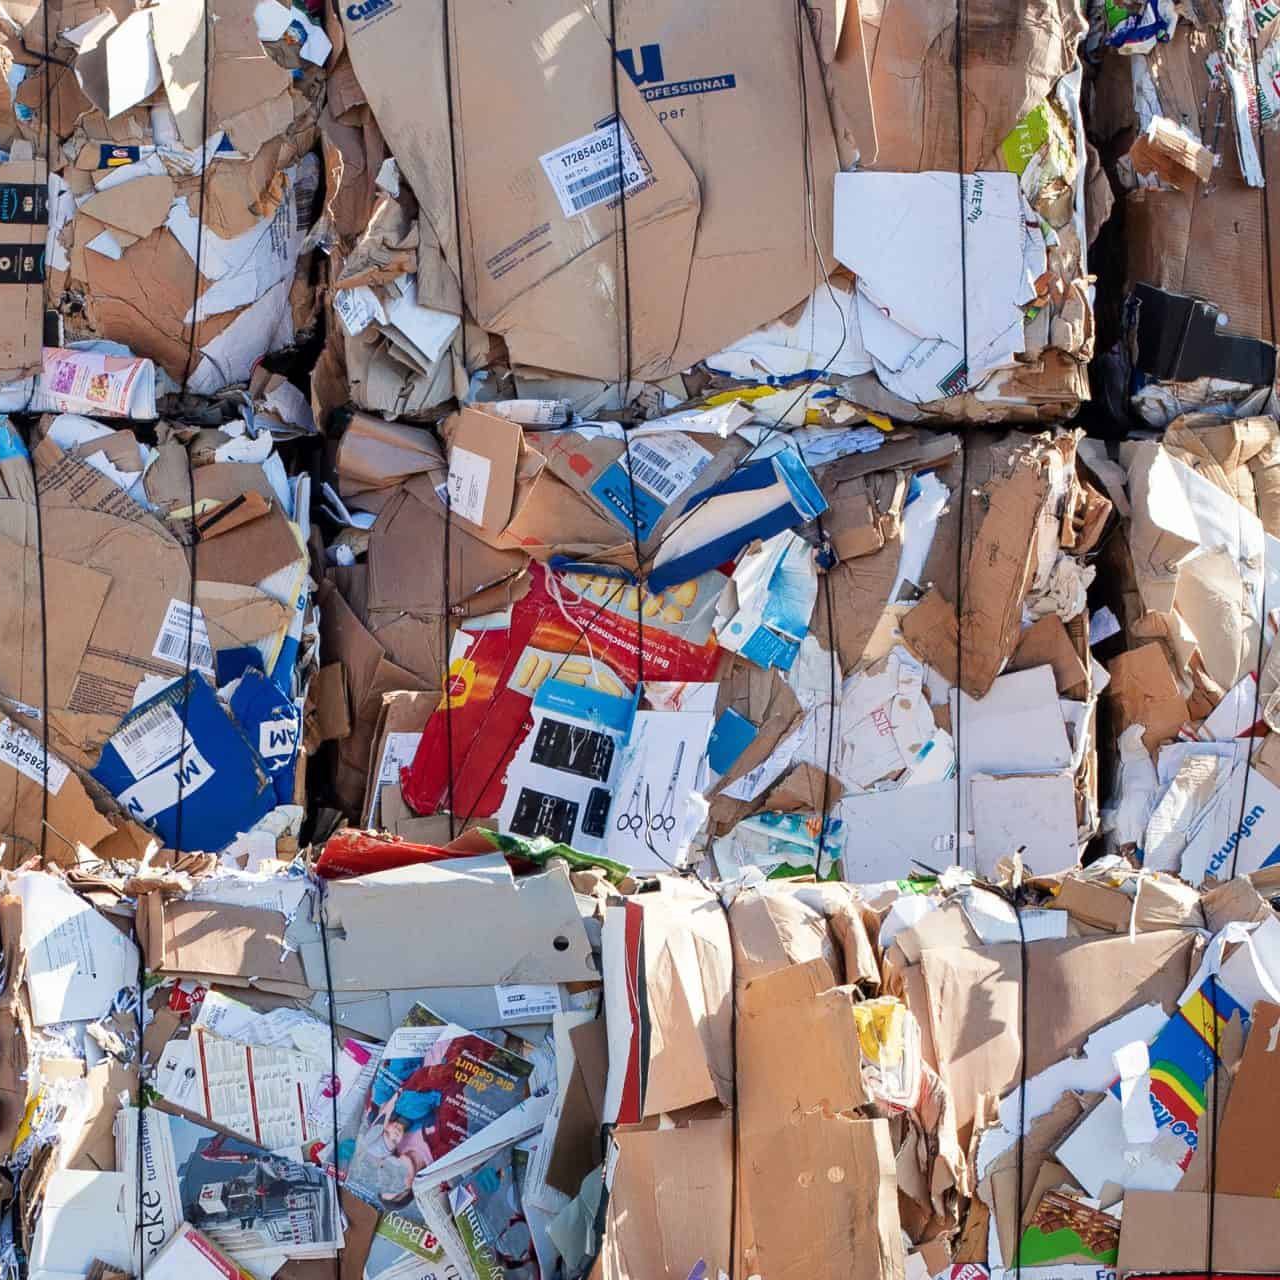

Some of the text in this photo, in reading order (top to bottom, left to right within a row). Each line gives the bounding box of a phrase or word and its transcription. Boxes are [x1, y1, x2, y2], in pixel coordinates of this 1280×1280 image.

[561, 137, 615, 167] 172854082
[652, 654, 671, 669] Bei
[381, 1211, 425, 1244] Baby
